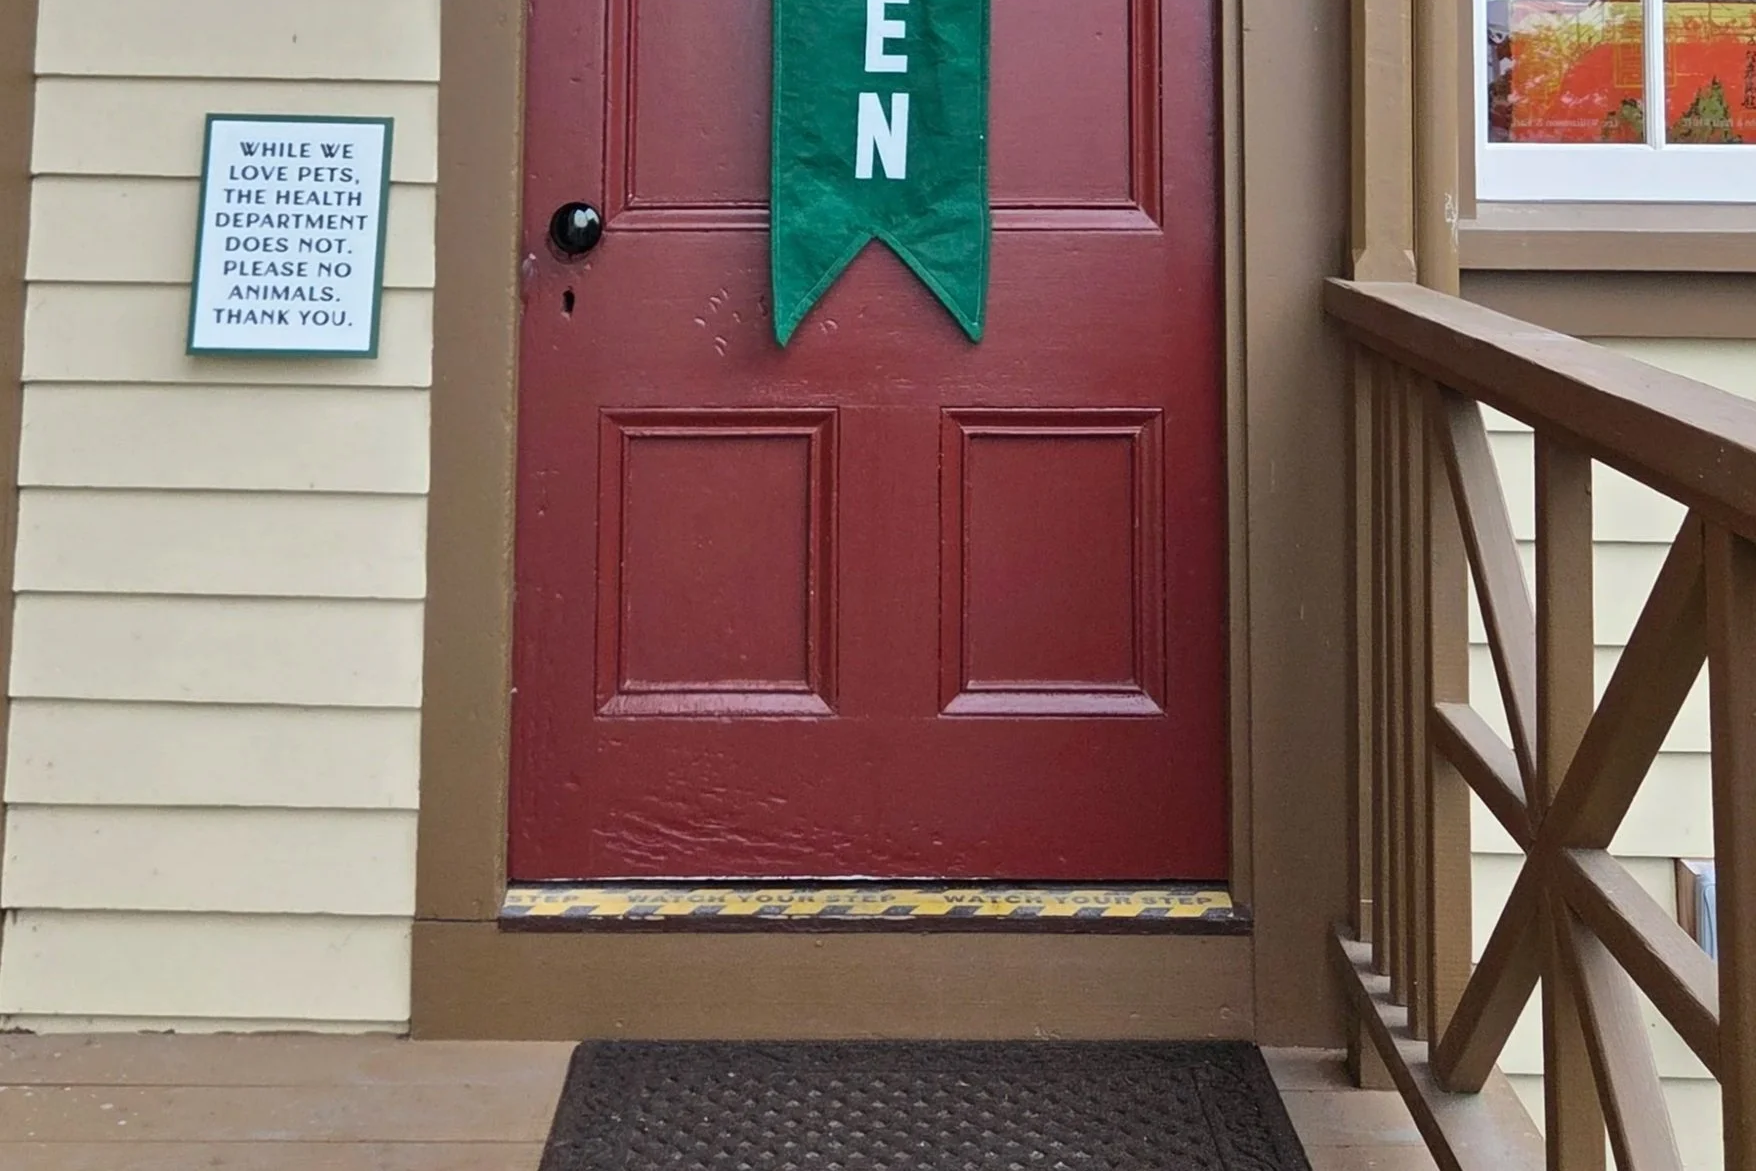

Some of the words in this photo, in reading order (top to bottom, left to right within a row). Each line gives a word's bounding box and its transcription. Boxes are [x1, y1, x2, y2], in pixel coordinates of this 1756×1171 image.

[240, 141, 311, 158] WHILE
[320, 143, 354, 159] WE
[229, 165, 288, 181] LOVE
[298, 166, 360, 185] PETS,
[223, 188, 267, 205] THE
[275, 190, 362, 206] HEALTH
[215, 212, 368, 230] DEPARTMENT
[225, 236, 288, 252] DOES
[298, 237, 352, 254] NOT.
[223, 260, 308, 277] PLEASE
[317, 262, 352, 278] NO
[227, 285, 341, 302] ANIMALS.
[212, 308, 290, 326] THANK
[299, 310, 353, 327] YOU.
[628, 893, 726, 904] WATCH
[738, 893, 814, 904] YOUR
[825, 893, 897, 903] STEP
[944, 894, 1042, 904] WATCH
[1056, 895, 1133, 905] YOUR
[1142, 896, 1213, 905] STEP
